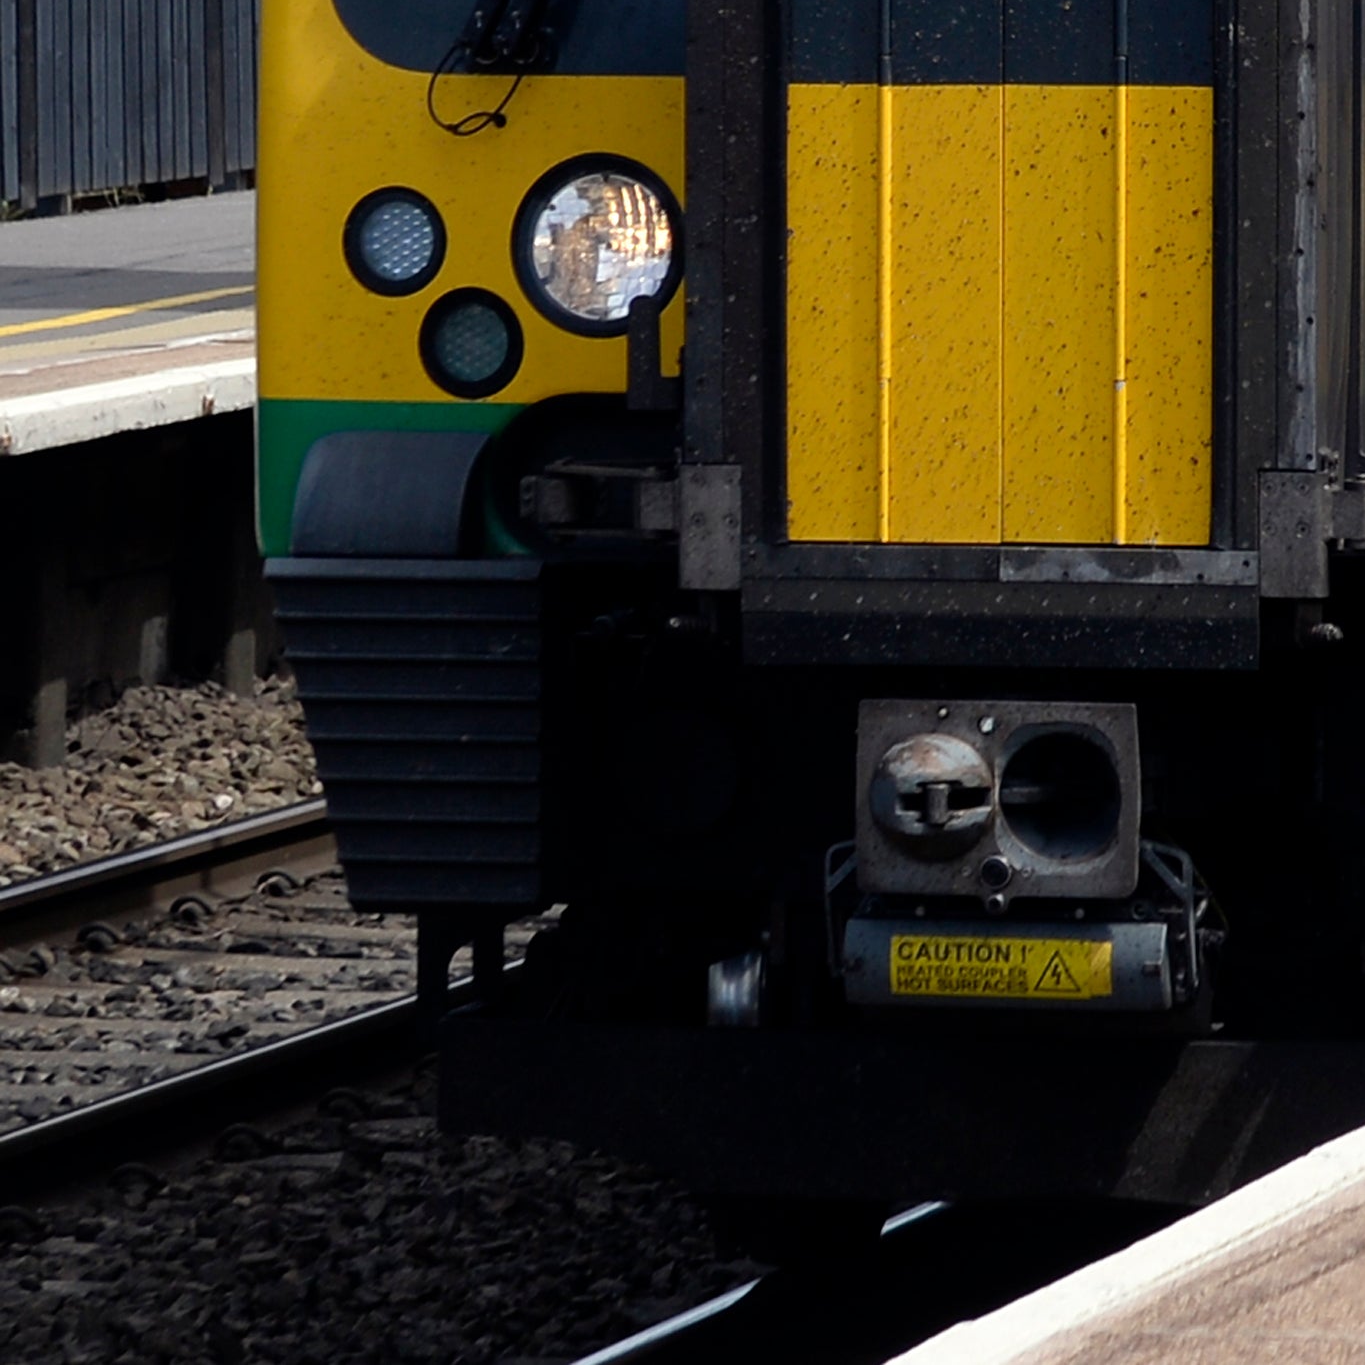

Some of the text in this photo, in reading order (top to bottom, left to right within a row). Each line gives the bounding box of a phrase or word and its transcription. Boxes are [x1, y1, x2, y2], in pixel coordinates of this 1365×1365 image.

[897, 941, 1010, 963] CAUTION
[896, 965, 1028, 978] HEATED COUPLER
[897, 978, 1029, 993] HOT SURFACES
